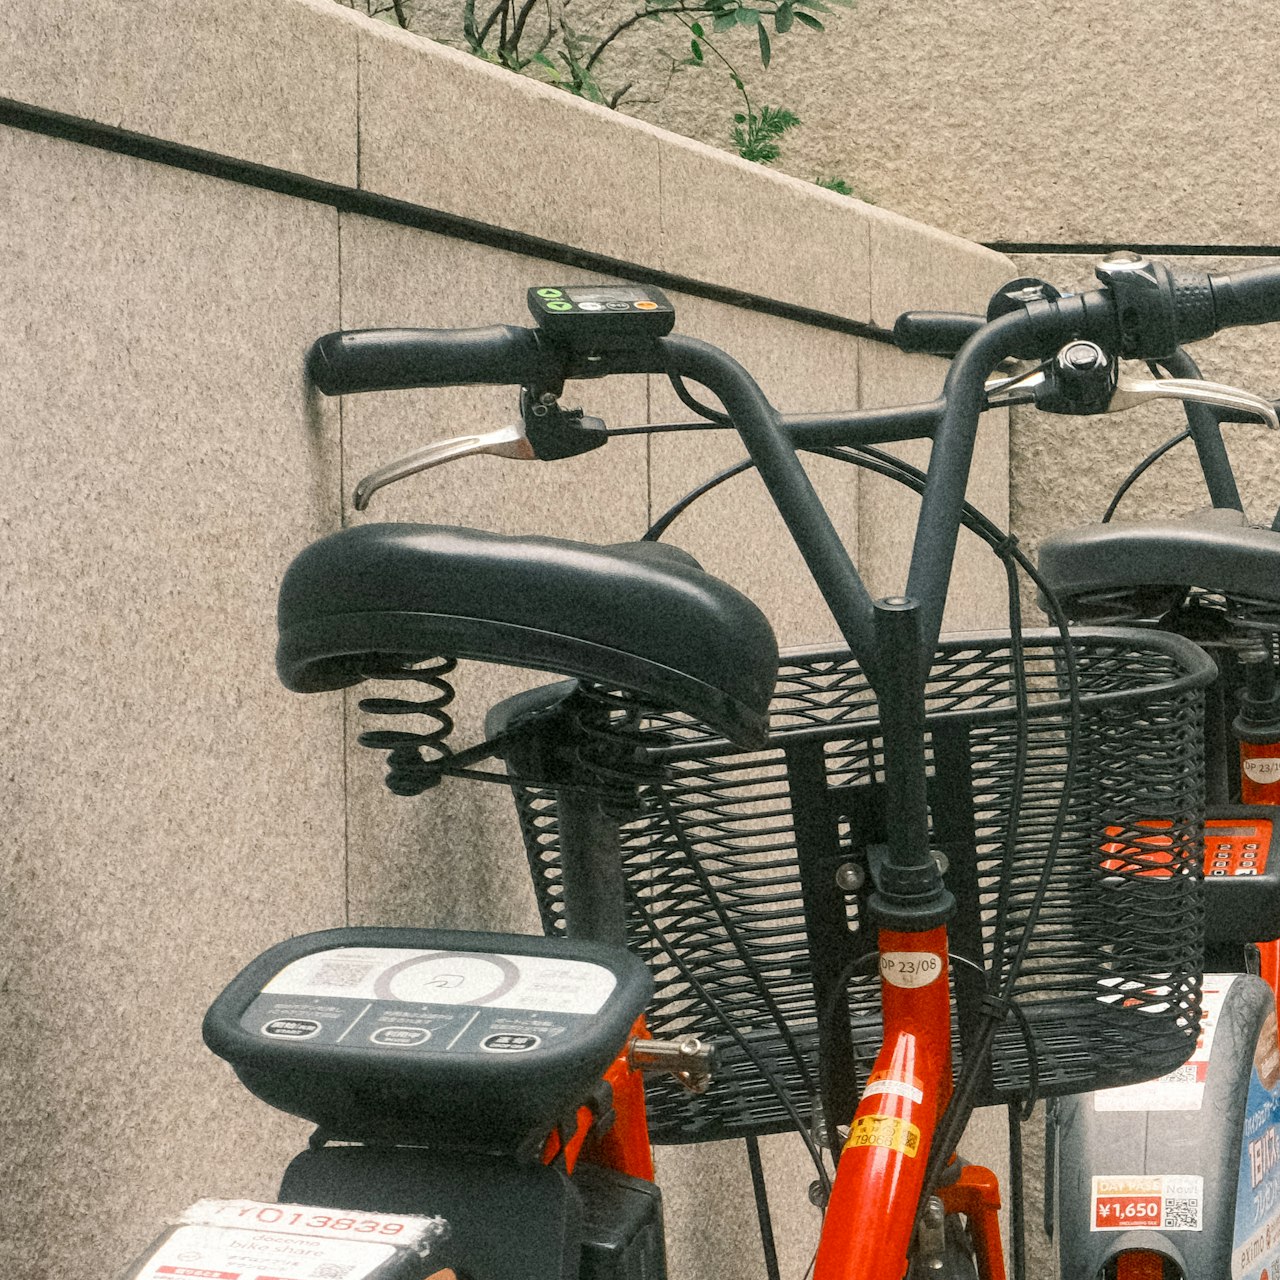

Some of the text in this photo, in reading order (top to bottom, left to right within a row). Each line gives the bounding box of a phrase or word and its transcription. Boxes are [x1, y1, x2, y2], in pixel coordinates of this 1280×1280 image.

[881, 957, 937, 973] DP 23/08
[1099, 1203, 1158, 1219] ¥1,650
[230, 1240, 324, 1258] bike share
[1241, 1235, 1265, 1269] eximo
